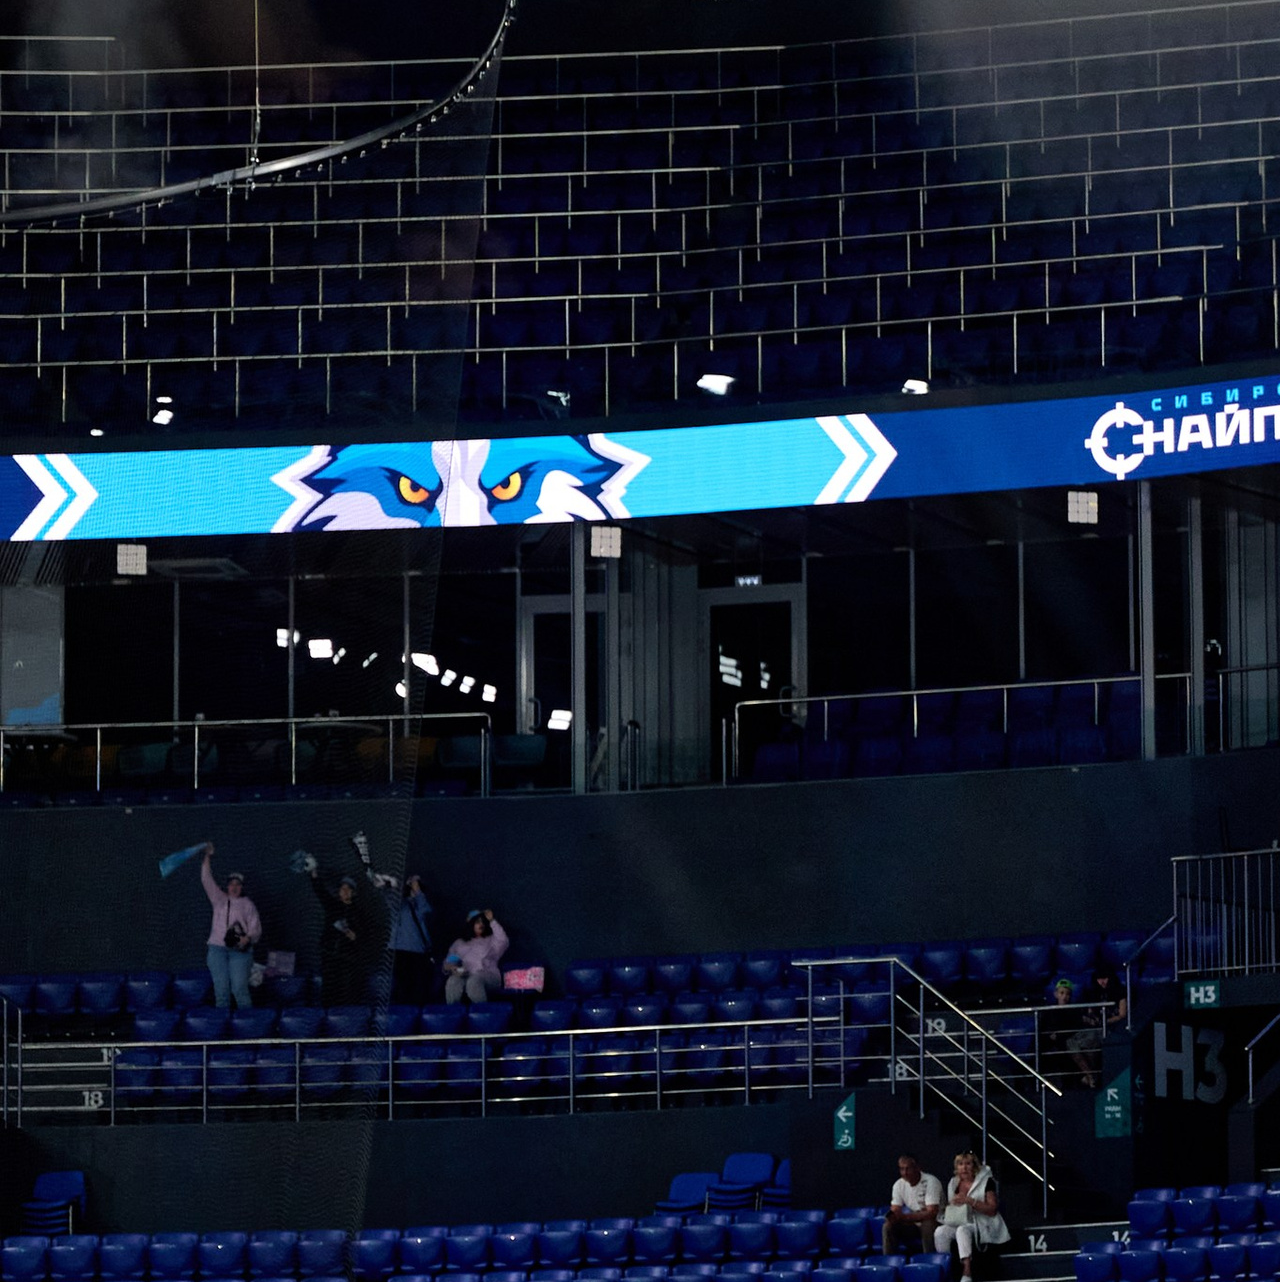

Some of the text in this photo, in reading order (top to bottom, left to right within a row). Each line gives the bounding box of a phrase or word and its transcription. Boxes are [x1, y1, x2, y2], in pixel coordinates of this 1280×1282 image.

[925, 1018, 946, 1033] 19
[82, 1090, 105, 1108] 18
[1028, 1234, 1048, 1253] 14
